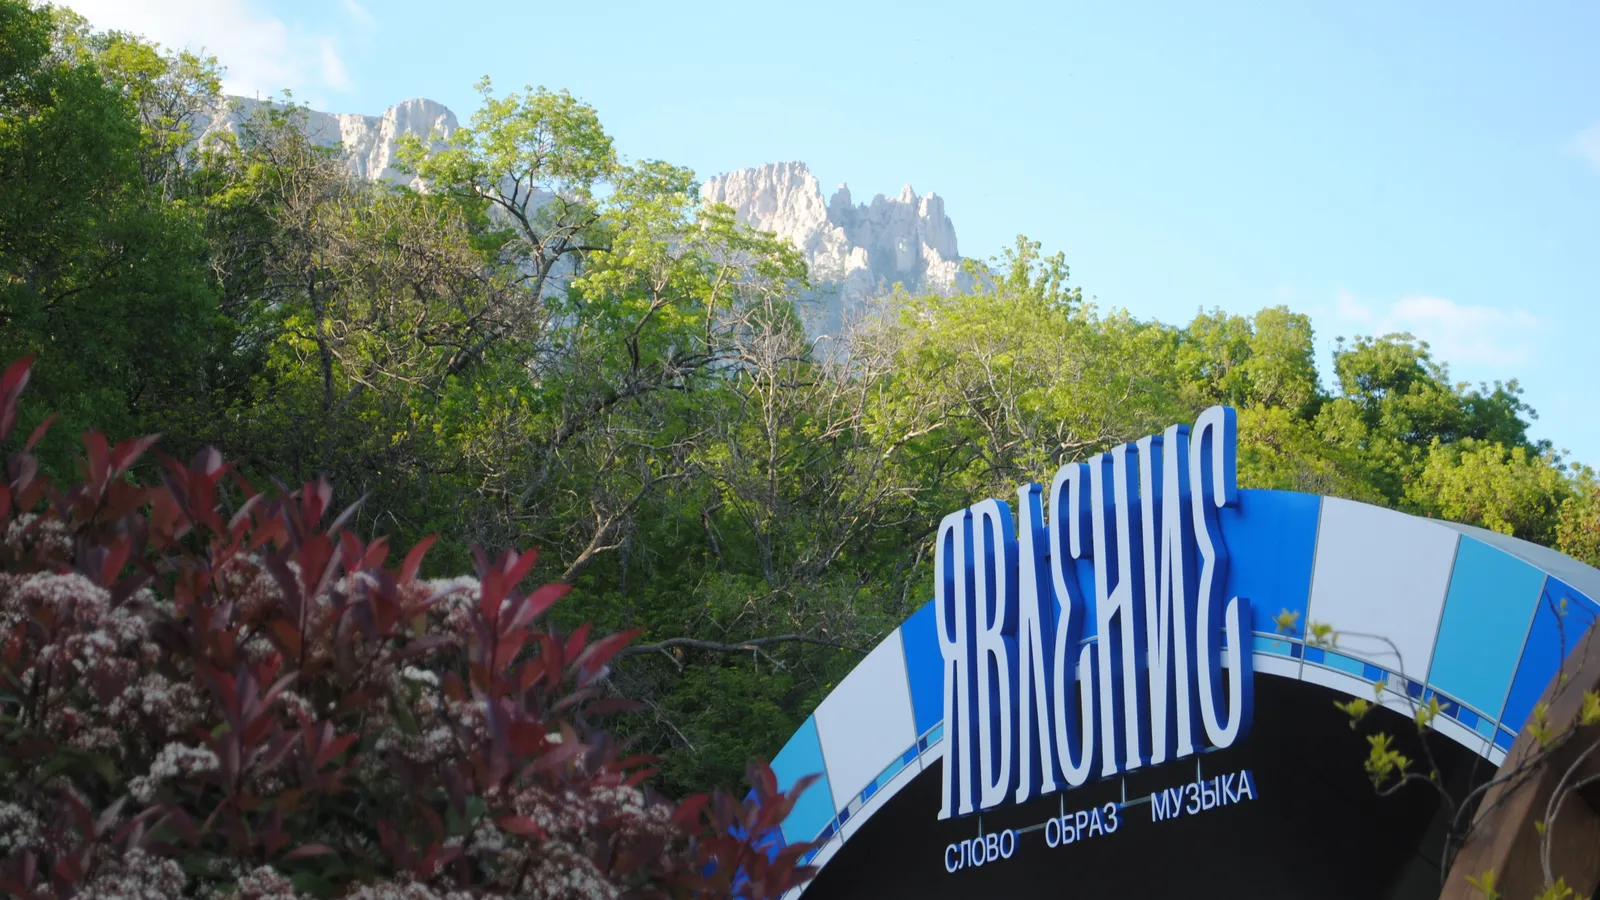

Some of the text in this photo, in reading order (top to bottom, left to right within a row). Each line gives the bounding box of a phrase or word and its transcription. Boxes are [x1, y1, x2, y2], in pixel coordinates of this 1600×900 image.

[935, 405, 1246, 820] ЯВЛЕНИЕ
[944, 769, 1254, 873] СЛОВО ОБРАЗ МУЗЫКА
